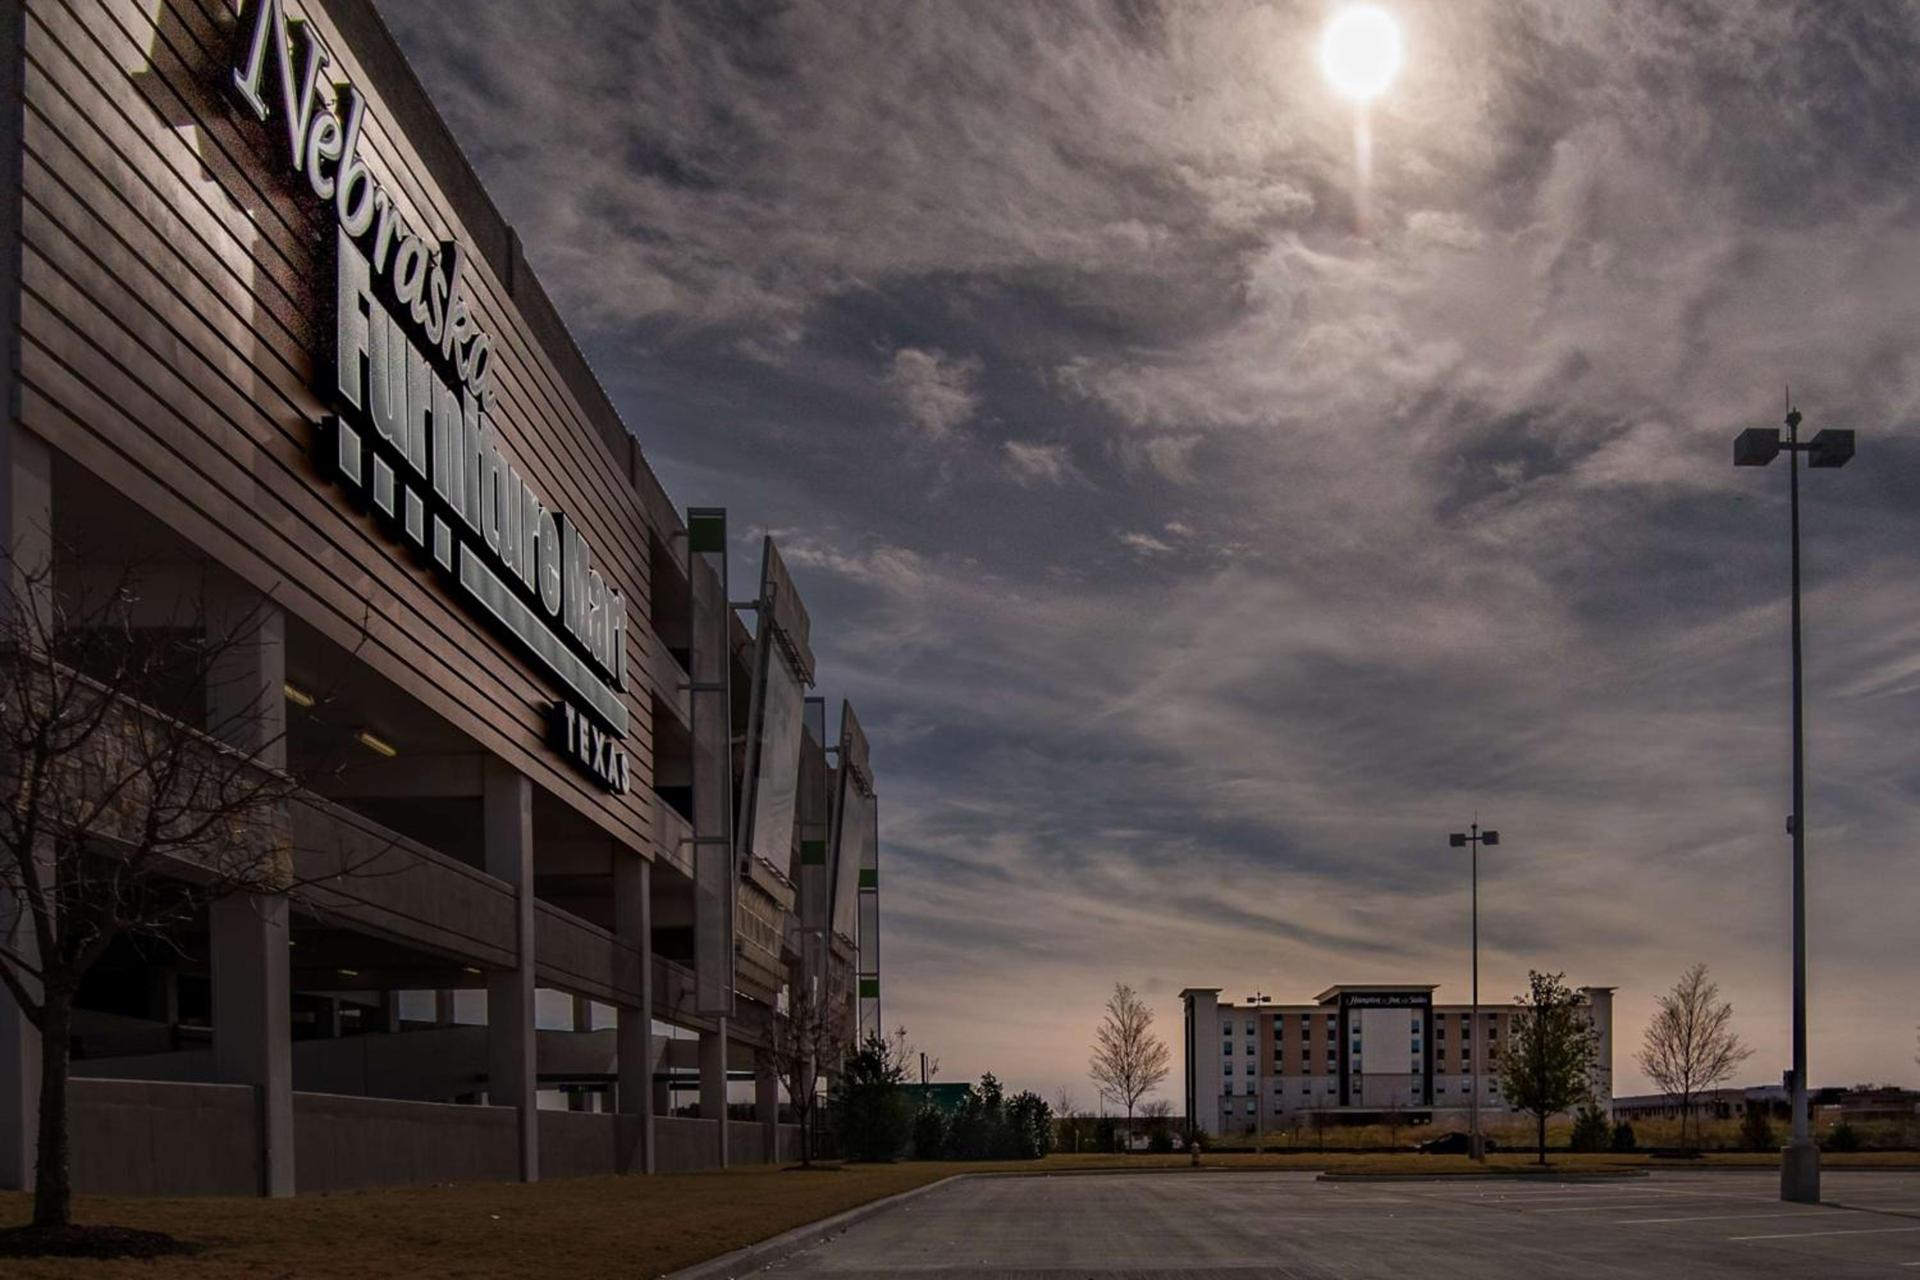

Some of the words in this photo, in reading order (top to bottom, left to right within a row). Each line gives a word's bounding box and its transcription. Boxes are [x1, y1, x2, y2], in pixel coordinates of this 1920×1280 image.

[234, 0, 496, 408] Nebraska
[338, 225, 561, 617] Furniture
[563, 513, 628, 693] Mart
[565, 705, 630, 795] TEXAS
